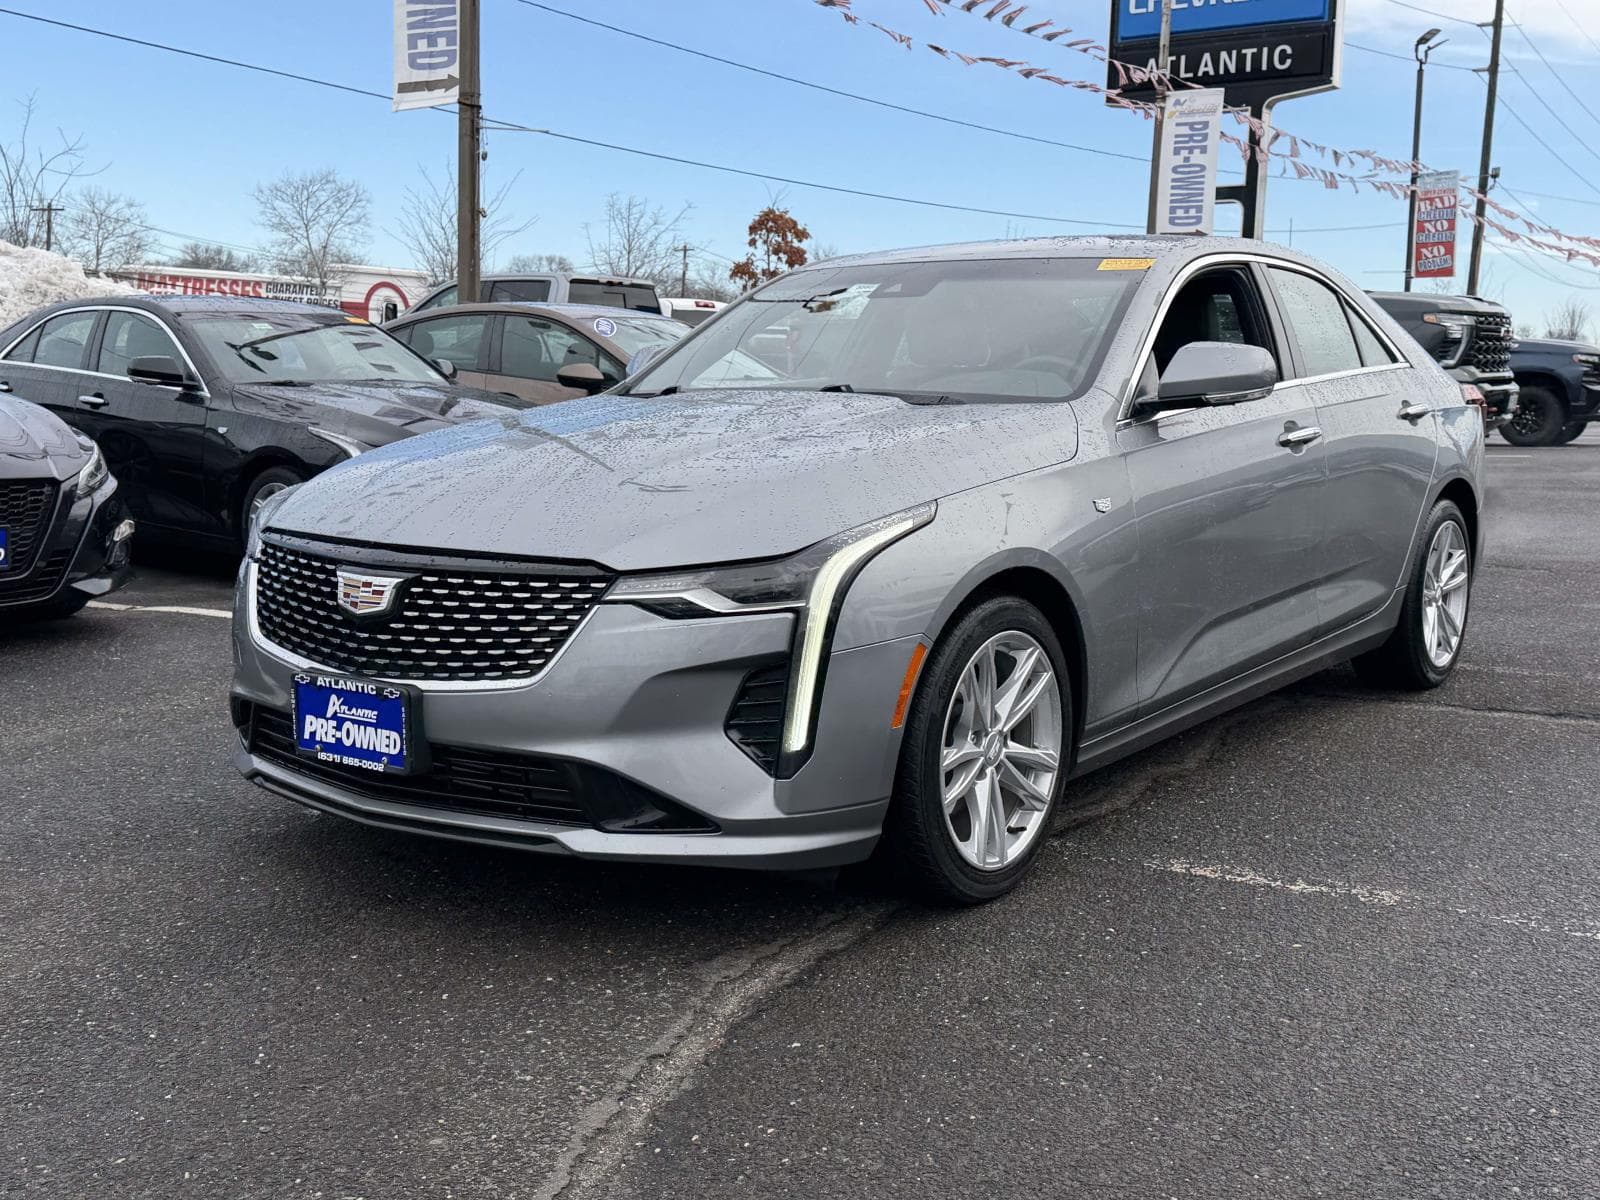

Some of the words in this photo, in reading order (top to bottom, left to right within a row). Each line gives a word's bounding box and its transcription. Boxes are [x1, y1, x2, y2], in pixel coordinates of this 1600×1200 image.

[1143, 44, 1293, 82] ATLANTIC
[1168, 121, 1209, 227] PRE-OWNED
[1419, 195, 1455, 211] BAD
[1424, 219, 1448, 233] NO
[1421, 245, 1445, 260] NO
[317, 677, 377, 695] ATLANTIC
[304, 714, 401, 755] PRE-OWNED
[317, 751, 341, 763] (631)
